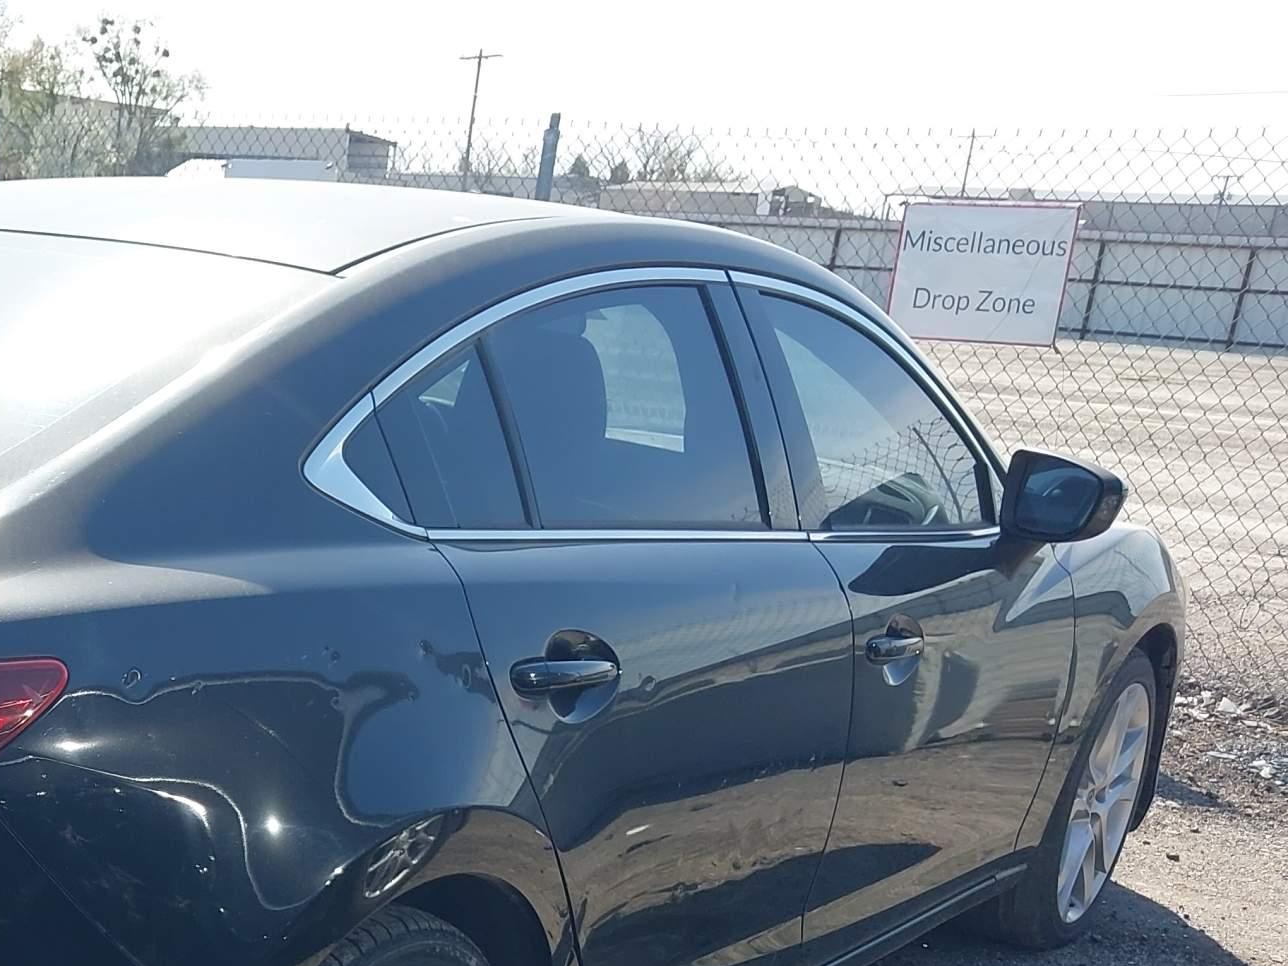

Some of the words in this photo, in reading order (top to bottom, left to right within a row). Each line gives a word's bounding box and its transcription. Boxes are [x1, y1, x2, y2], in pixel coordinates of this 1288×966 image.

[903, 230, 1068, 257] Miscellaneous
[912, 287, 969, 315] Drop
[975, 290, 1036, 314] Zone
